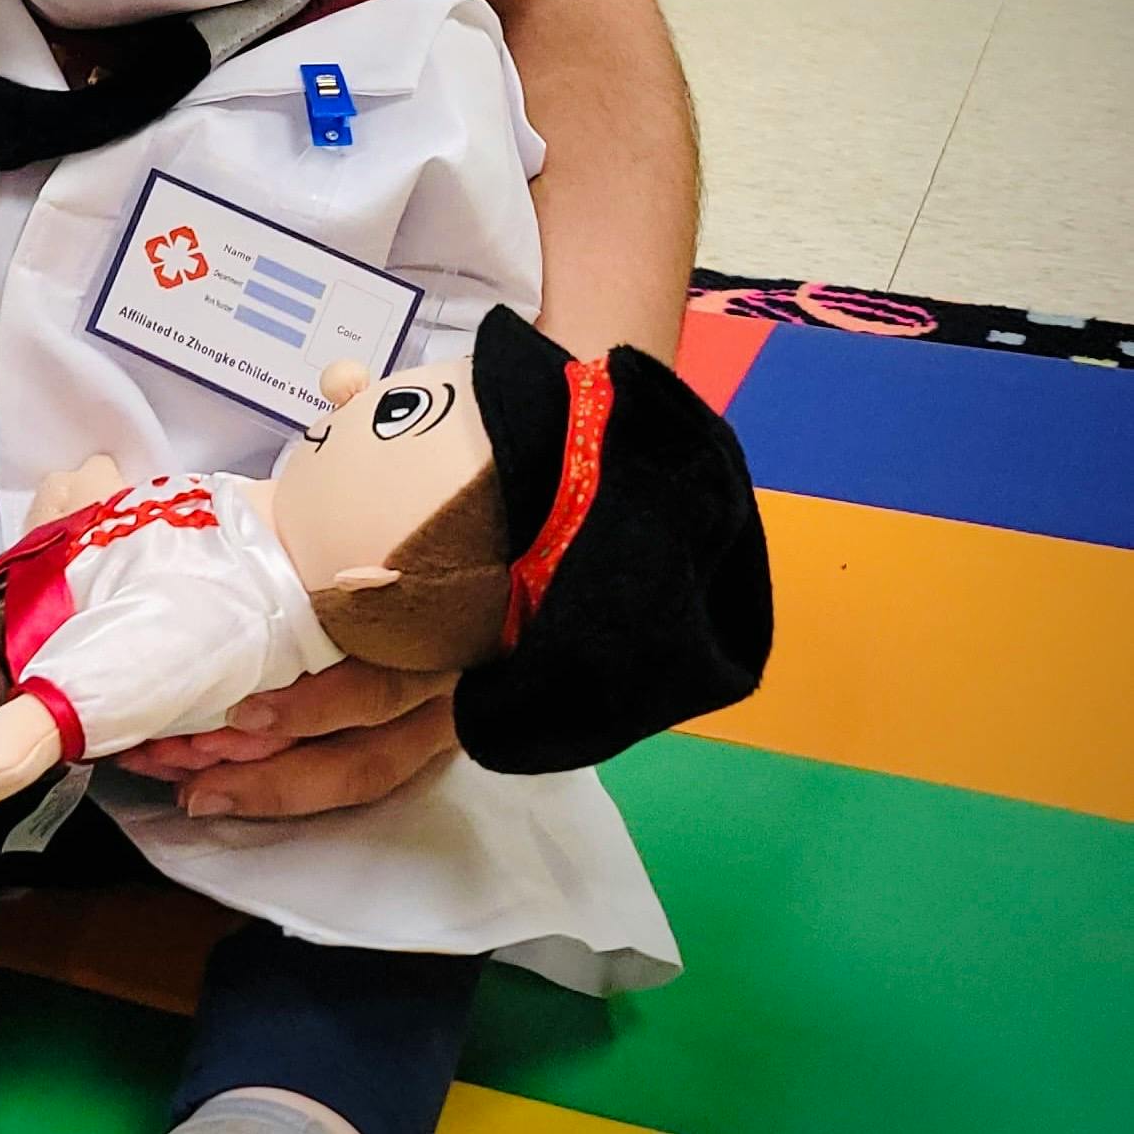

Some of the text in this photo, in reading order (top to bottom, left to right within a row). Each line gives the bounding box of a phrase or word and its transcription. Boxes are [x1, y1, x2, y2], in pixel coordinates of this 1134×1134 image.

[222, 243, 252, 262] Name
[337, 325, 362, 342] Color
[118, 306, 337, 413] Affiliated to Zhongke Children's Hospi
